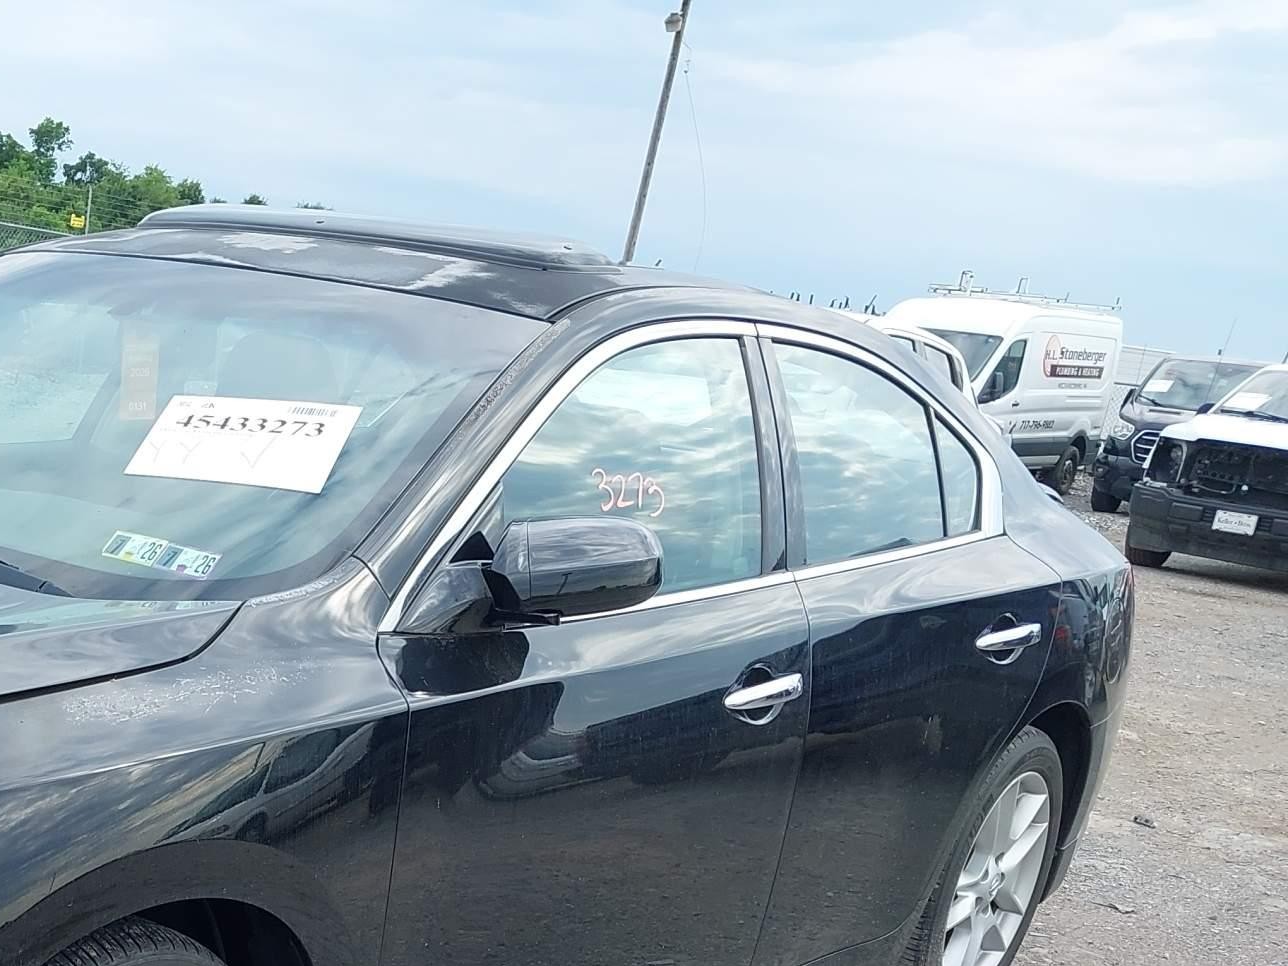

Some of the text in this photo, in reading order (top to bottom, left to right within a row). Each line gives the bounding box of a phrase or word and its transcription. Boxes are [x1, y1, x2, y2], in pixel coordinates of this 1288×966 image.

[176, 413, 326, 438] 45433273
[591, 467, 665, 518] 3273
[140, 542, 162, 560] 26
[194, 555, 217, 575] 26
